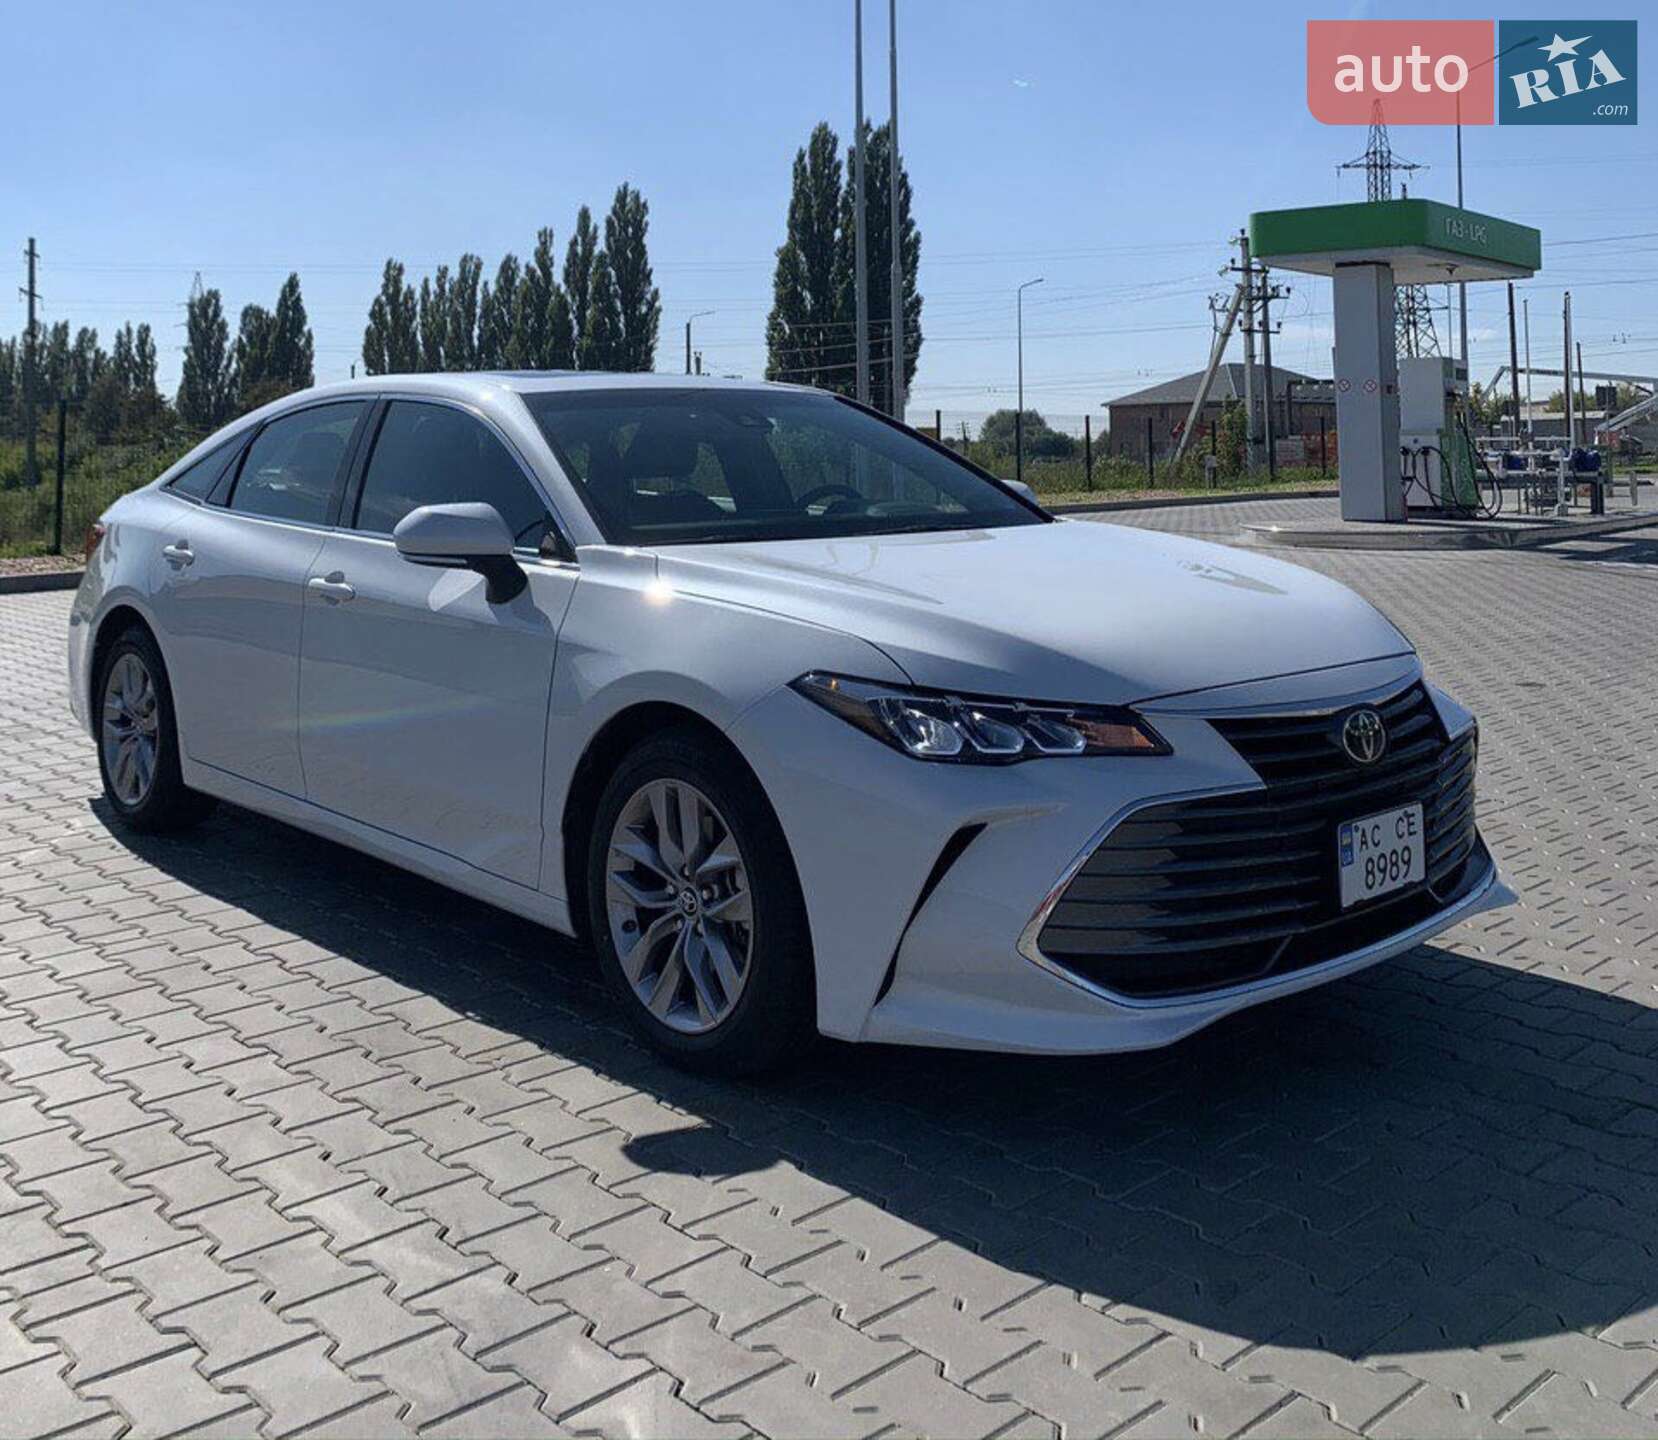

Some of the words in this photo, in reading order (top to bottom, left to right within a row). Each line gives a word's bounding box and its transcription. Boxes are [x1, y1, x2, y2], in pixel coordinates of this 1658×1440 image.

[1360, 824, 1381, 850] AC
[1395, 812, 1417, 838] CE
[1365, 845, 1412, 890] 8989
